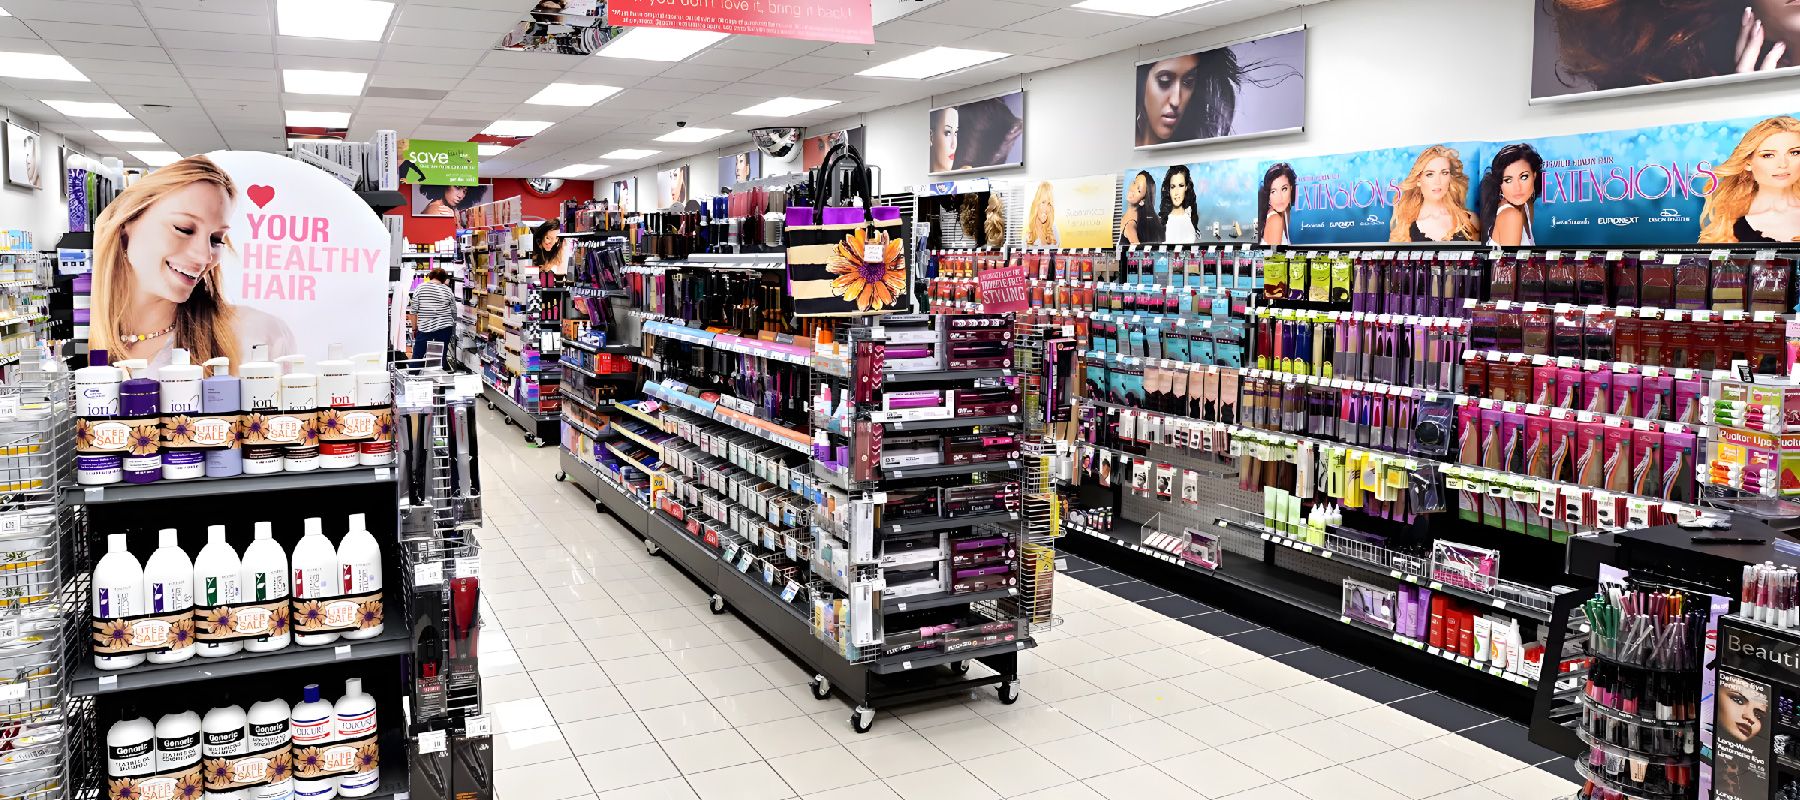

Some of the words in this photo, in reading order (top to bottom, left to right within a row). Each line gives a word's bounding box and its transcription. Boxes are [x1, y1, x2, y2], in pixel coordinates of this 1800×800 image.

[721, 0, 749, 11] love
[768, 3, 801, 17] bring
[409, 152, 449, 164] save
[1541, 159, 1719, 204] EXTENSIONS
[1294, 178, 1402, 211] EXTENSIONS
[246, 213, 329, 243] YOUR
[243, 243, 381, 274] HEALTHY
[242, 272, 317, 301] HAIR
[982, 287, 1025, 304] STYLING
[252, 395, 272, 408] ion
[88, 403, 109, 416] ion
[271, 429, 297, 438] SALE
[346, 424, 370, 433] SALE
[96, 435, 125, 446] SALE
[197, 431, 224, 441] SALE
[328, 614, 353, 624] SALE
[239, 620, 267, 631] SALE
[136, 634, 165, 643] SALE
[209, 731, 239, 741] Generic
[1717, 736, 1754, 754] Long-Wear
[1717, 750, 1734, 761] Liner
[327, 757, 352, 769] SALE
[238, 769, 263, 780] SALE
[143, 790, 171, 800] SALE
